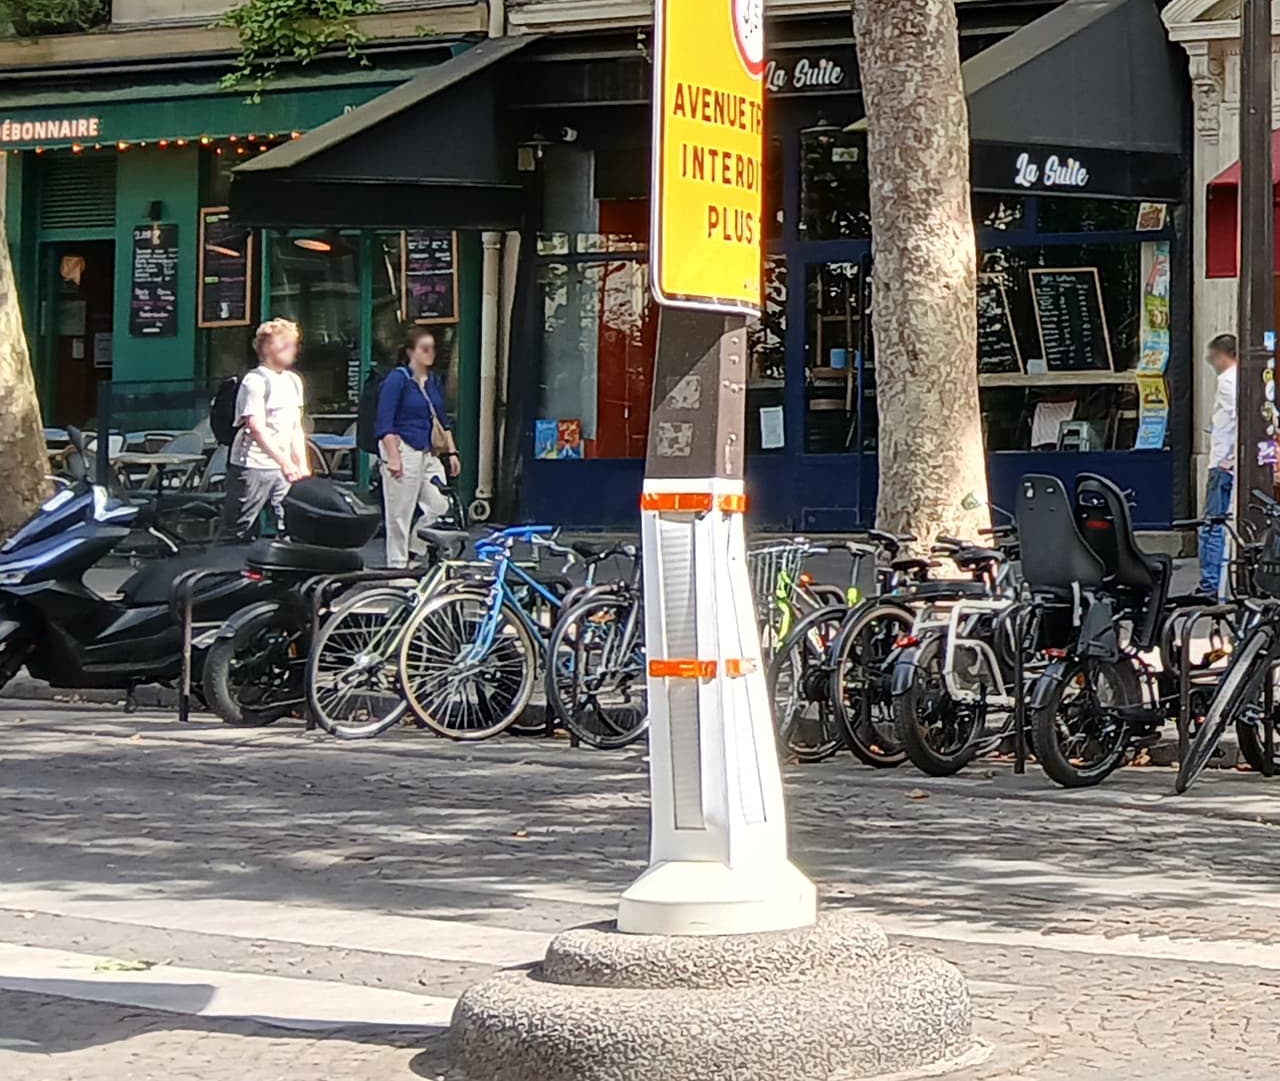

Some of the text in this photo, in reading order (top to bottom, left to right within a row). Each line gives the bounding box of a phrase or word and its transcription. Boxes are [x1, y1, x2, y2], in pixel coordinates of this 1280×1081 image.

[764, 58, 844, 91] La Suite
[673, 82, 746, 131] AVENUE
[0, 118, 99, 141] ÉBONNAIRE
[682, 143, 762, 193] INTERDI
[1014, 152, 1090, 188] La Suite
[708, 205, 753, 245] PLUS
